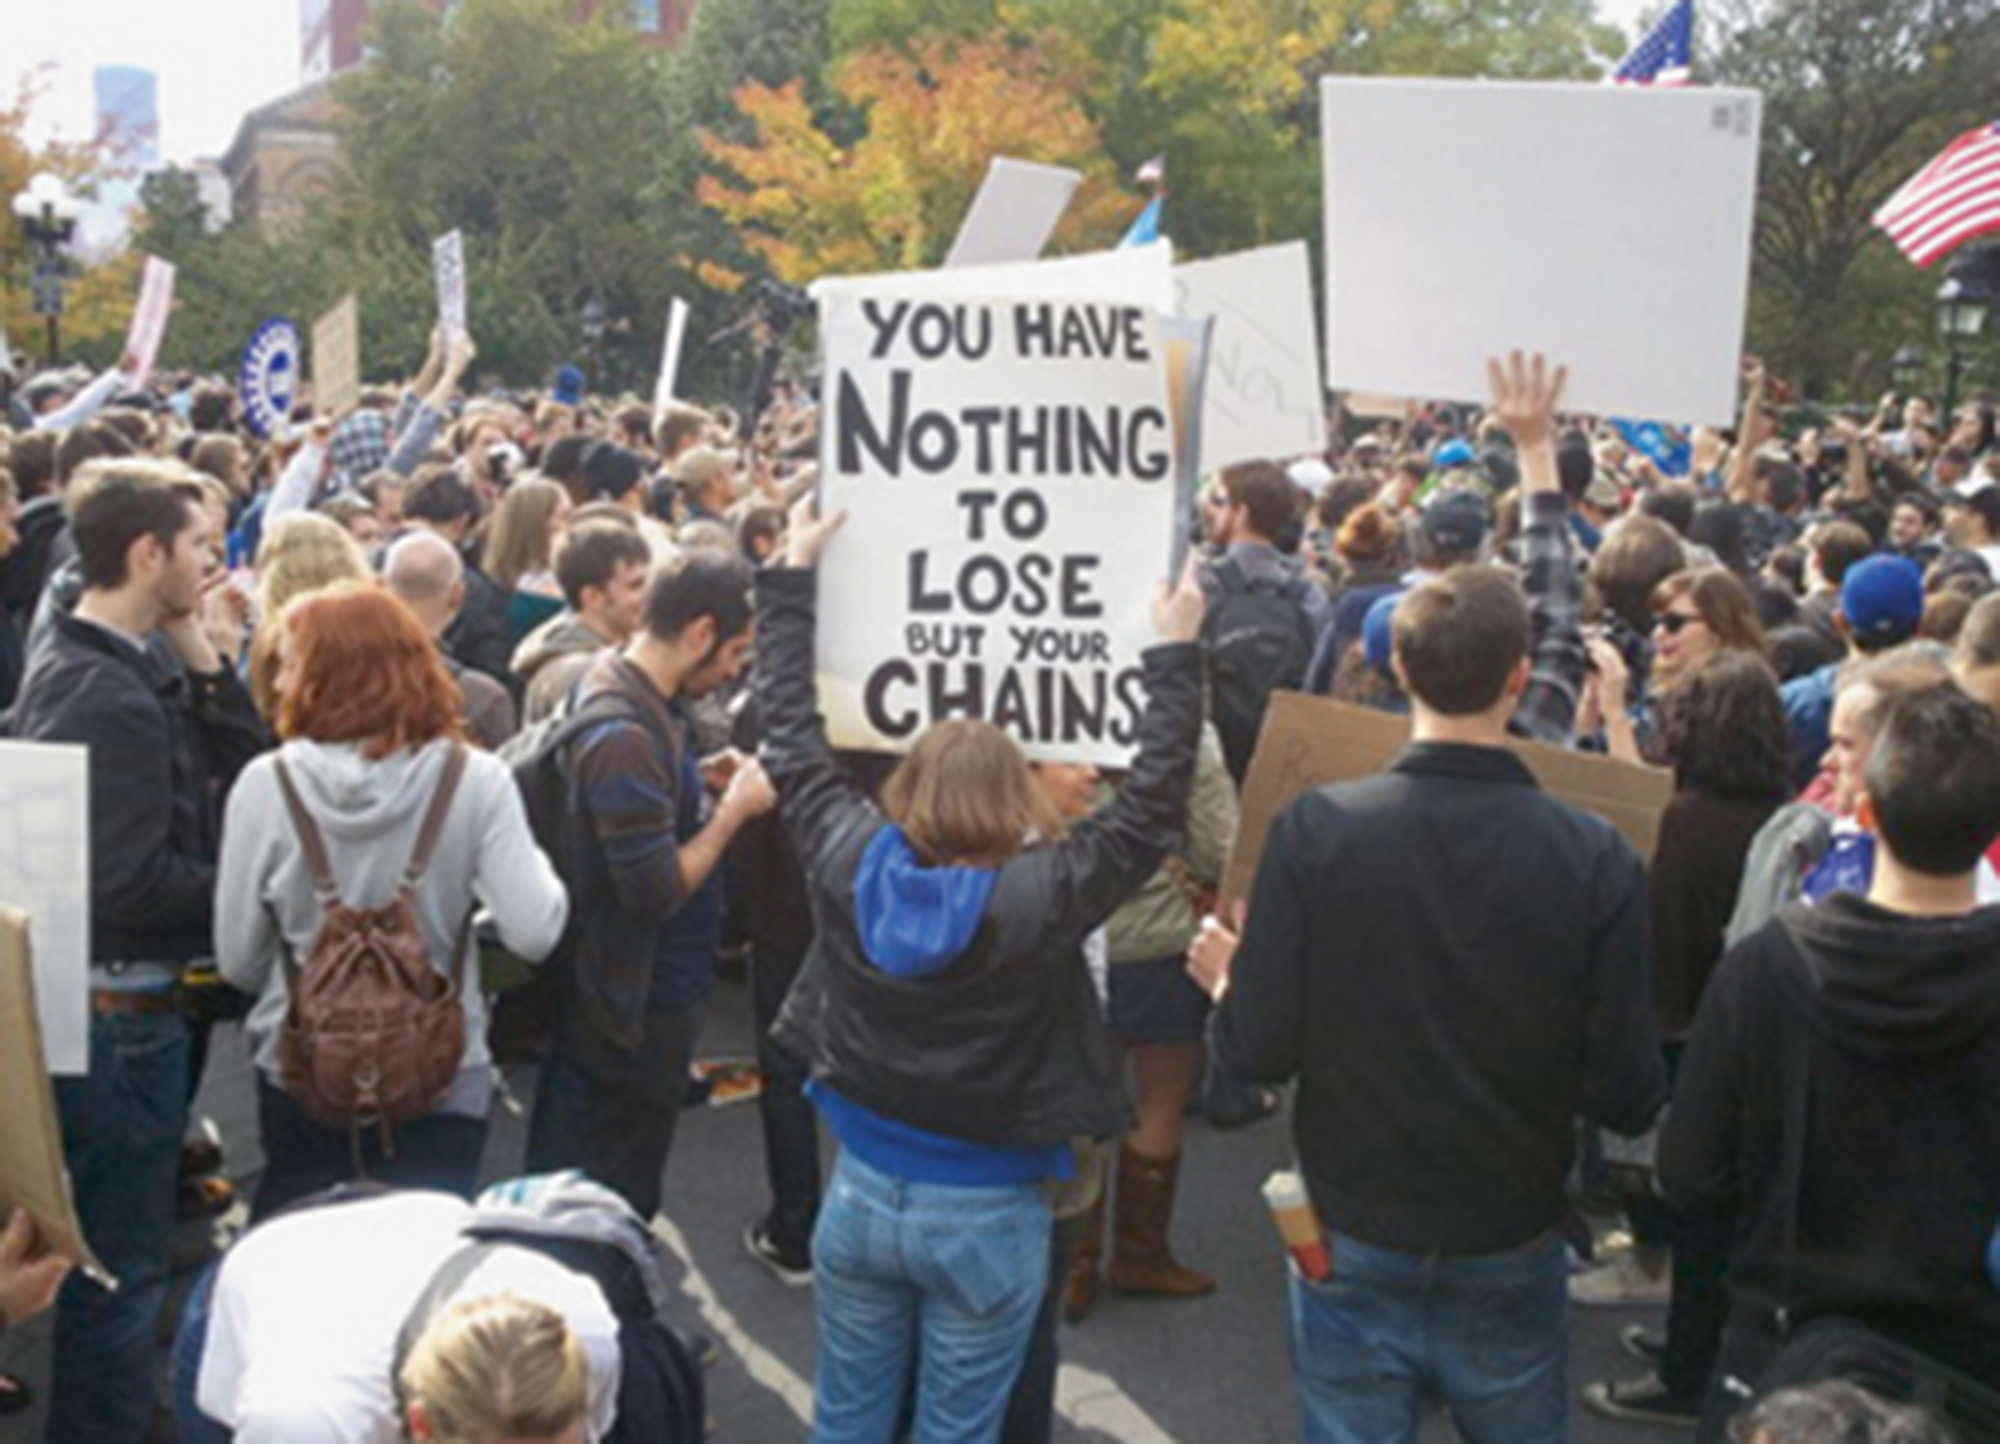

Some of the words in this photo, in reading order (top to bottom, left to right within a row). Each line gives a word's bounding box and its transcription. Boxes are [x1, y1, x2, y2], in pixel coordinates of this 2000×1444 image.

[863, 300, 990, 360] YOU
[1014, 303, 1149, 361] HAVE
[837, 369, 1168, 480] NOTHING
[958, 489, 1047, 540] TO
[909, 550, 1103, 617] LOSE
[906, 623, 984, 657] BUT
[1009, 625, 1109, 663] YOUR
[864, 658, 1146, 746] CHAINS
